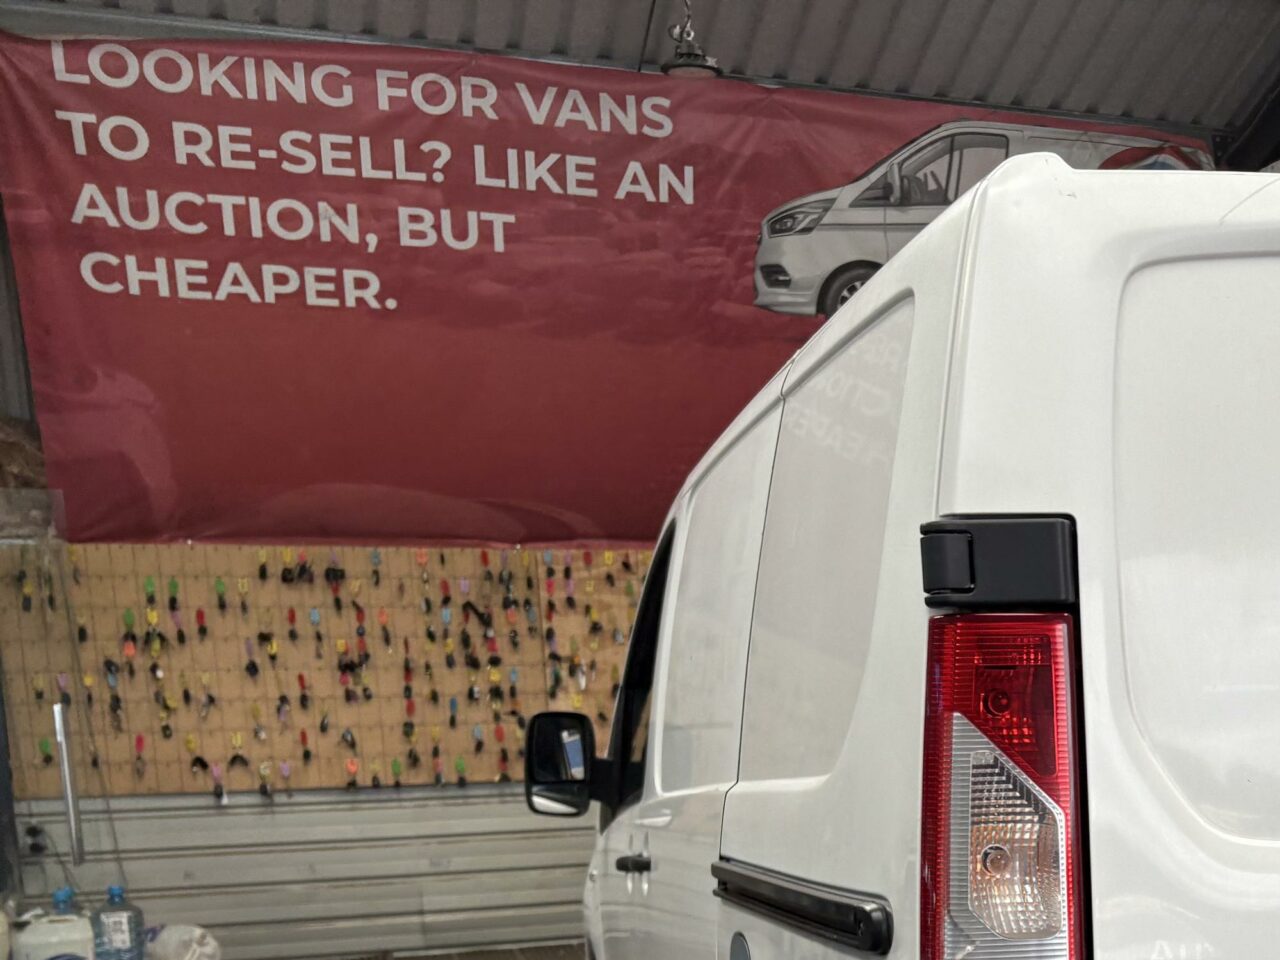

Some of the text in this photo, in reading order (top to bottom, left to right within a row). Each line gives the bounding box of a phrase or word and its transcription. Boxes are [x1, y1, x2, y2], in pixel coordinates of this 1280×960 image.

[50, 40, 674, 138] LOOKING FOR VANS
[55, 109, 695, 205] TO RE-SELL? LIKE AN
[71, 183, 516, 253] AUCTION, BUT
[79, 251, 398, 310] CHEAPER.
